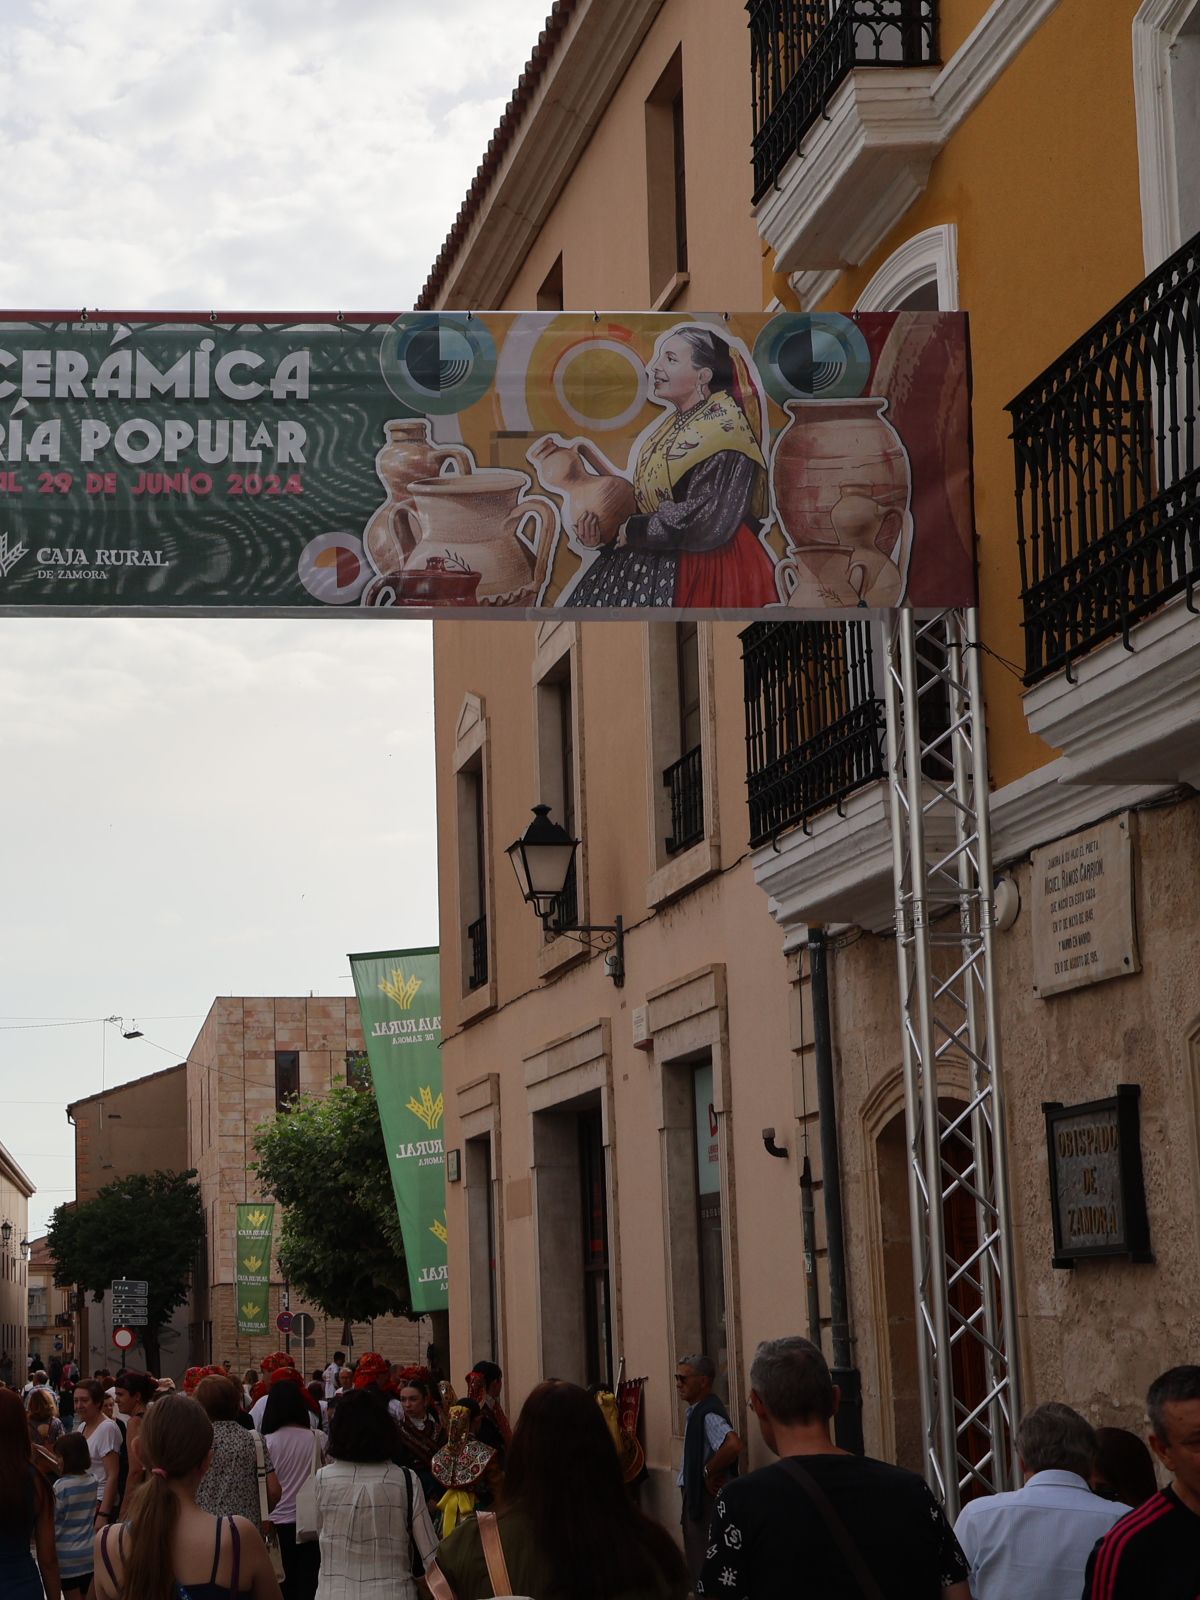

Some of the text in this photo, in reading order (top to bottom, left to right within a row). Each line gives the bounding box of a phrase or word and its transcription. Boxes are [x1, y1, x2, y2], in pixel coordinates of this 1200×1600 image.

[80, 418, 307, 464] POPULAR
[37, 472, 73, 493] 29
[86, 473, 117, 494] DE
[130, 468, 213, 495] JUNIO
[226, 474, 305, 495] 2024
[36, 548, 169, 566] CAJA RURAL
[37, 570, 107, 579] DE ZAMORA
[1058, 1126, 1120, 1158] OBISPADO
[1081, 1166, 1097, 1195] DE
[1068, 1205, 1118, 1236] ZAMORA
